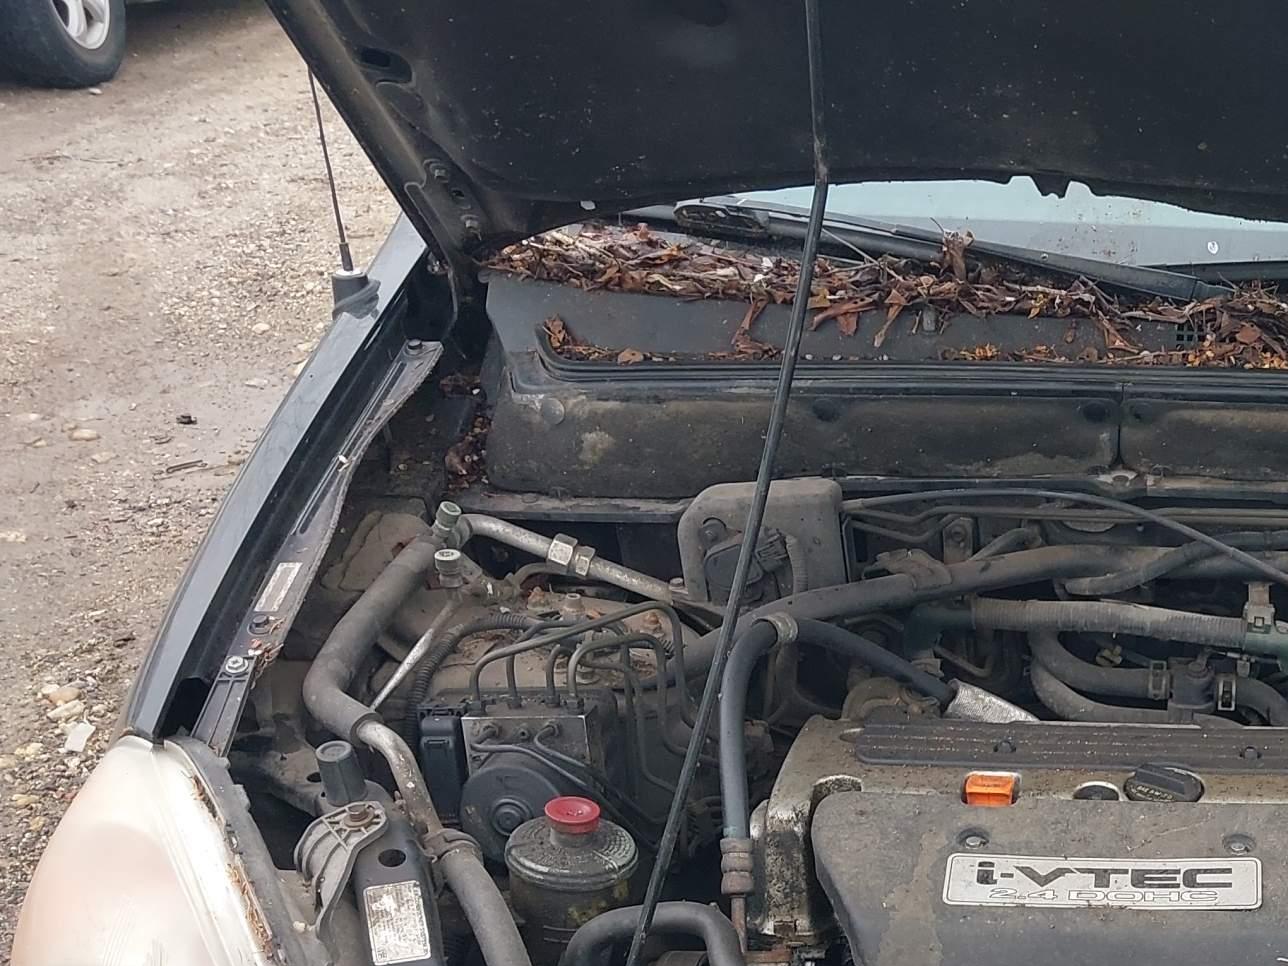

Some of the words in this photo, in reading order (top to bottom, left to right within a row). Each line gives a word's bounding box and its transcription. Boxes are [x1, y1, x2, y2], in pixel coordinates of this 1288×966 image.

[976, 861, 1233, 889] i-VTEC
[989, 887, 1058, 901] 2.4
[1068, 890, 1218, 902] DOHC
